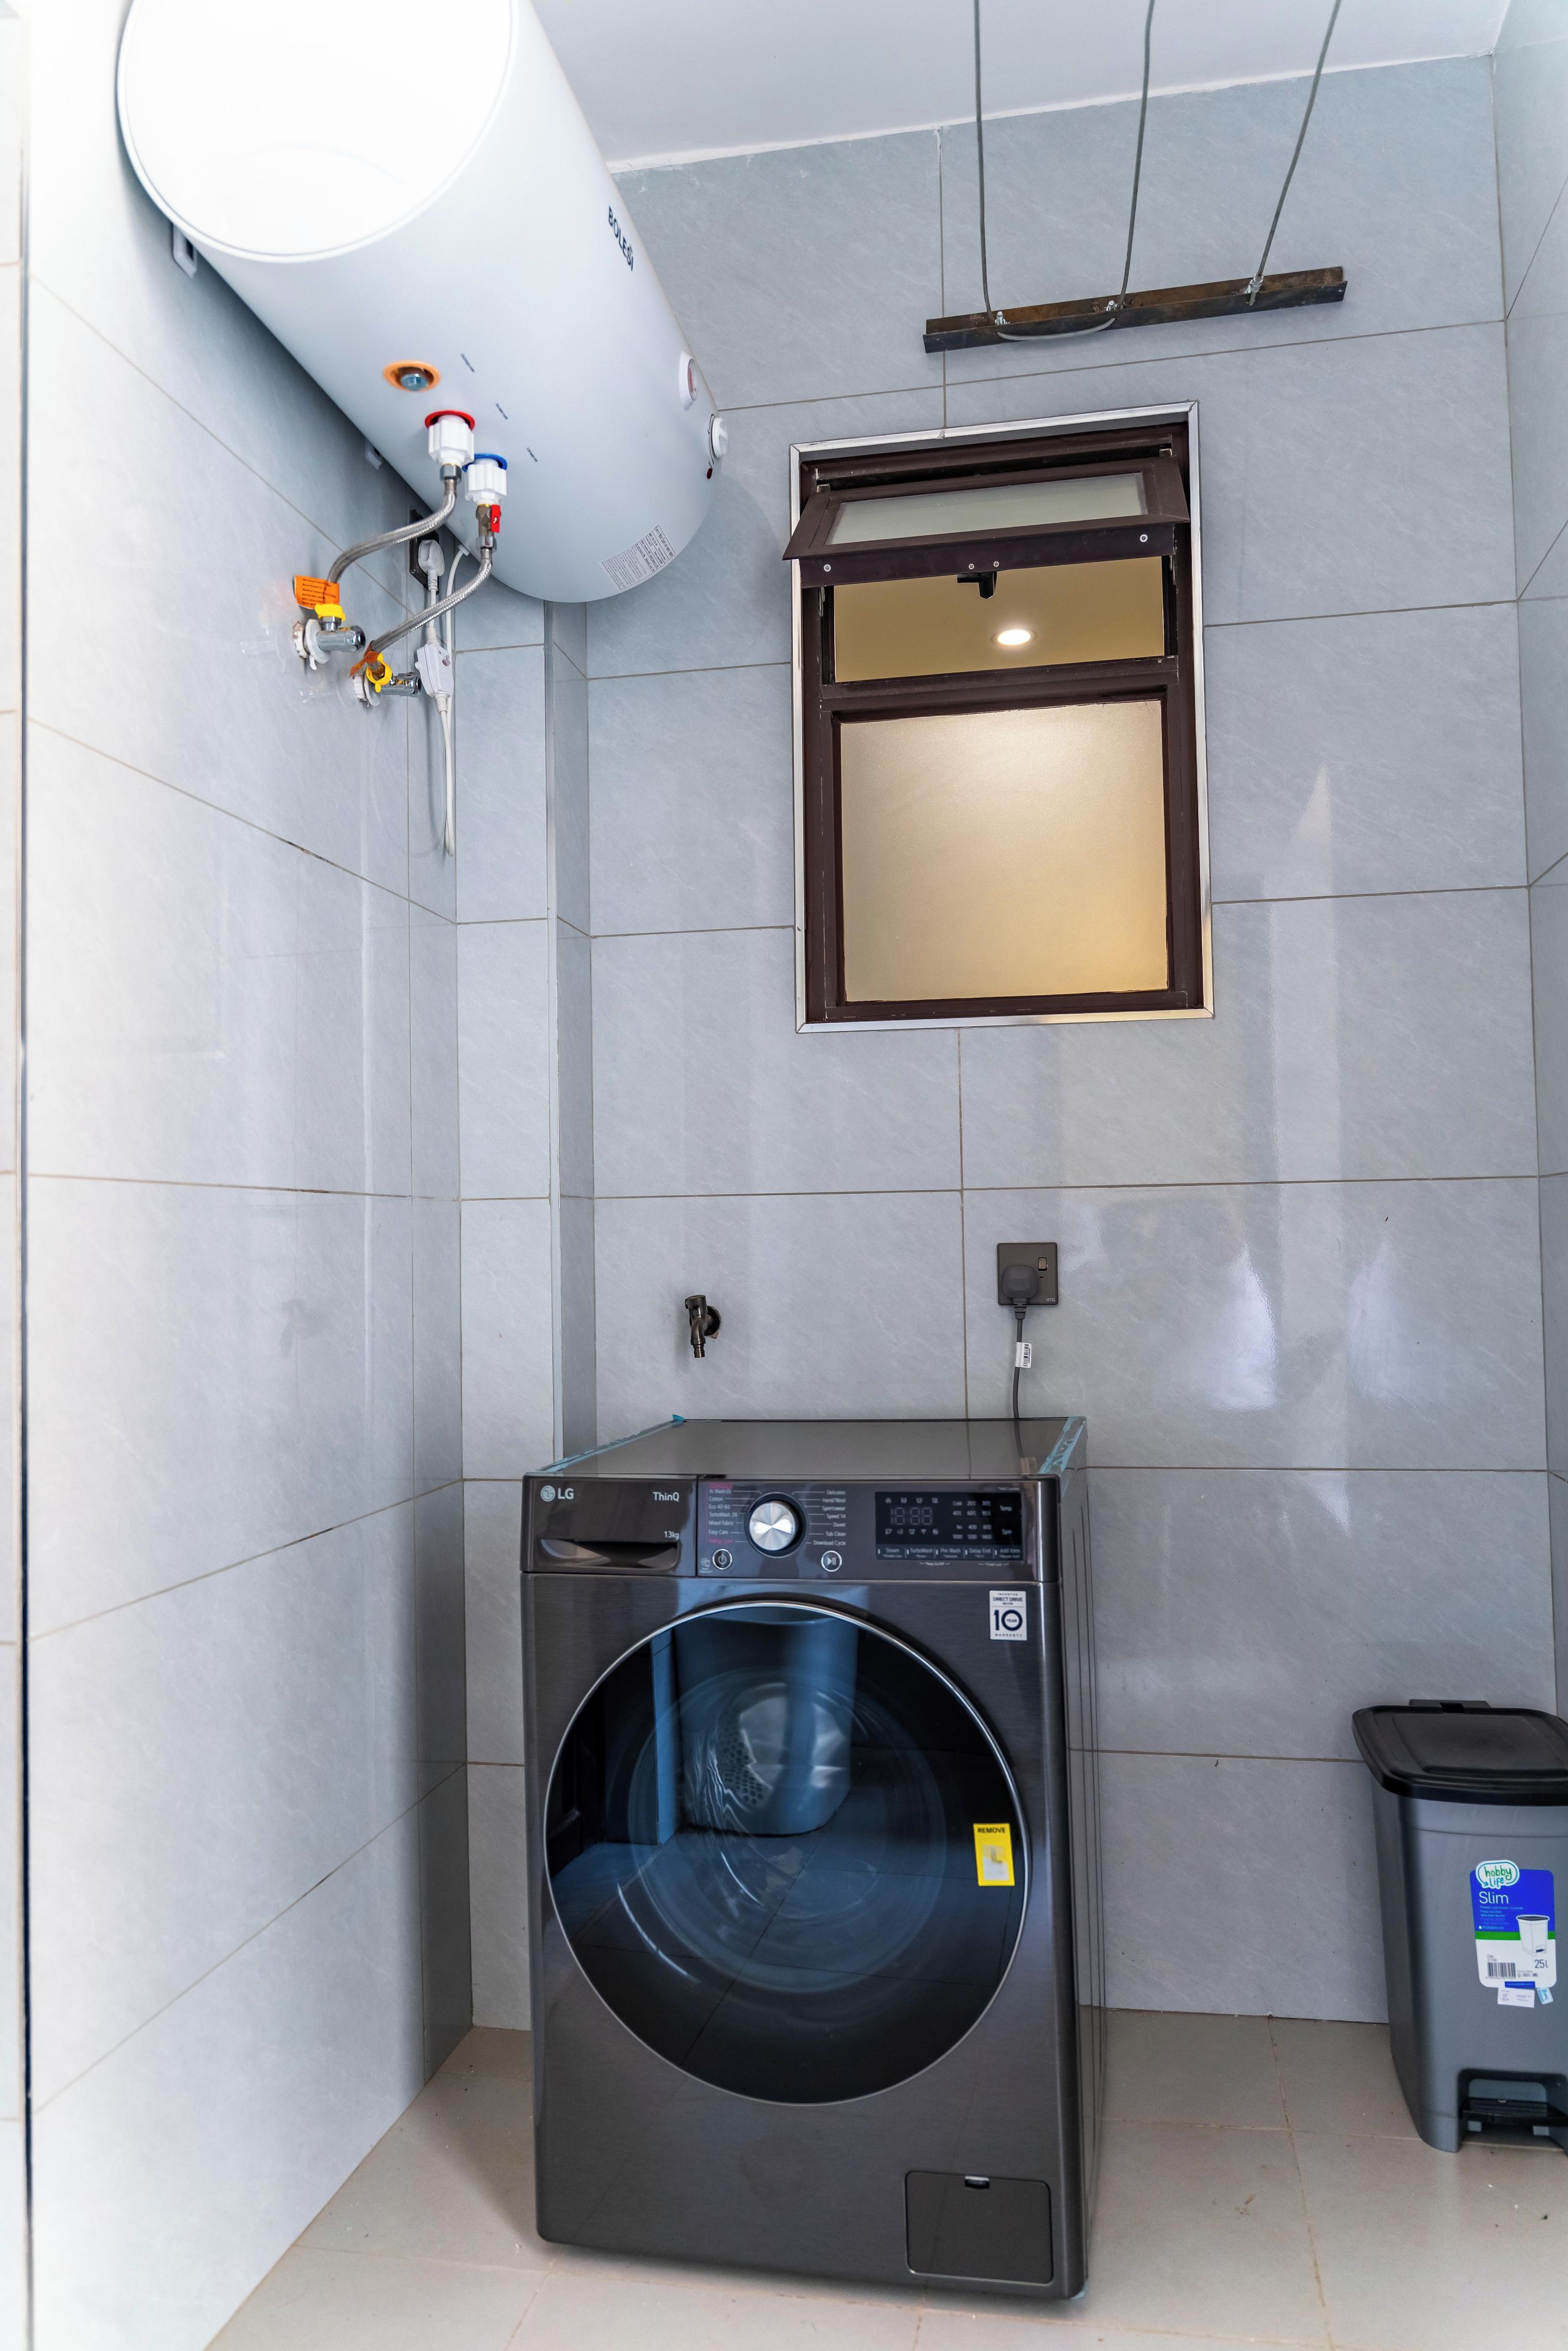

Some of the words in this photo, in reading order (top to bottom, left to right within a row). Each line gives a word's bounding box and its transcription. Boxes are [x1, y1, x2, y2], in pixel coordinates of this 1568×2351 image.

[558, 1488, 574, 1499] LG
[653, 1491, 680, 1502] ThinQ
[664, 1531, 679, 1540] 13kg
[994, 1609, 1023, 1632] 10
[1484, 1865, 1512, 1881] hobby
[1479, 1891, 1509, 1904] Slim
